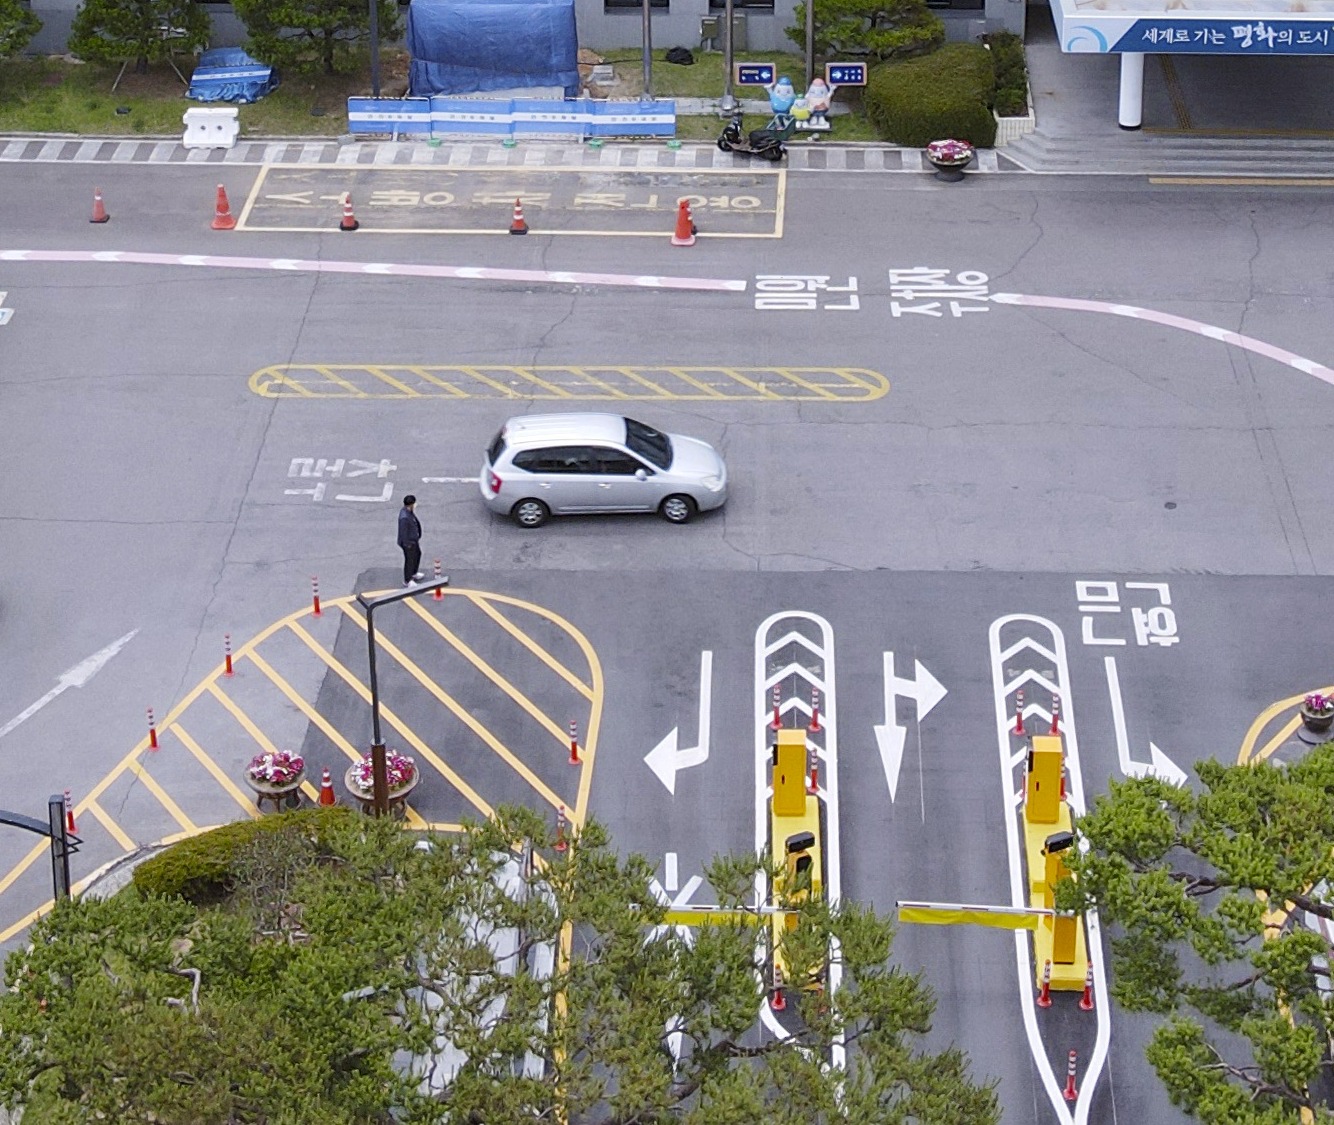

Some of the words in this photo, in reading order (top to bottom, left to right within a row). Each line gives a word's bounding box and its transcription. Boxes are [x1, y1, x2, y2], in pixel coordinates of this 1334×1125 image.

[1141, 27, 1191, 45] 세계로
[1194, 27, 1227, 45] 가는
[1231, 20, 1294, 49] 평화의
[1296, 28, 1329, 45] 도시
[1075, 580, 1180, 647] 현금
